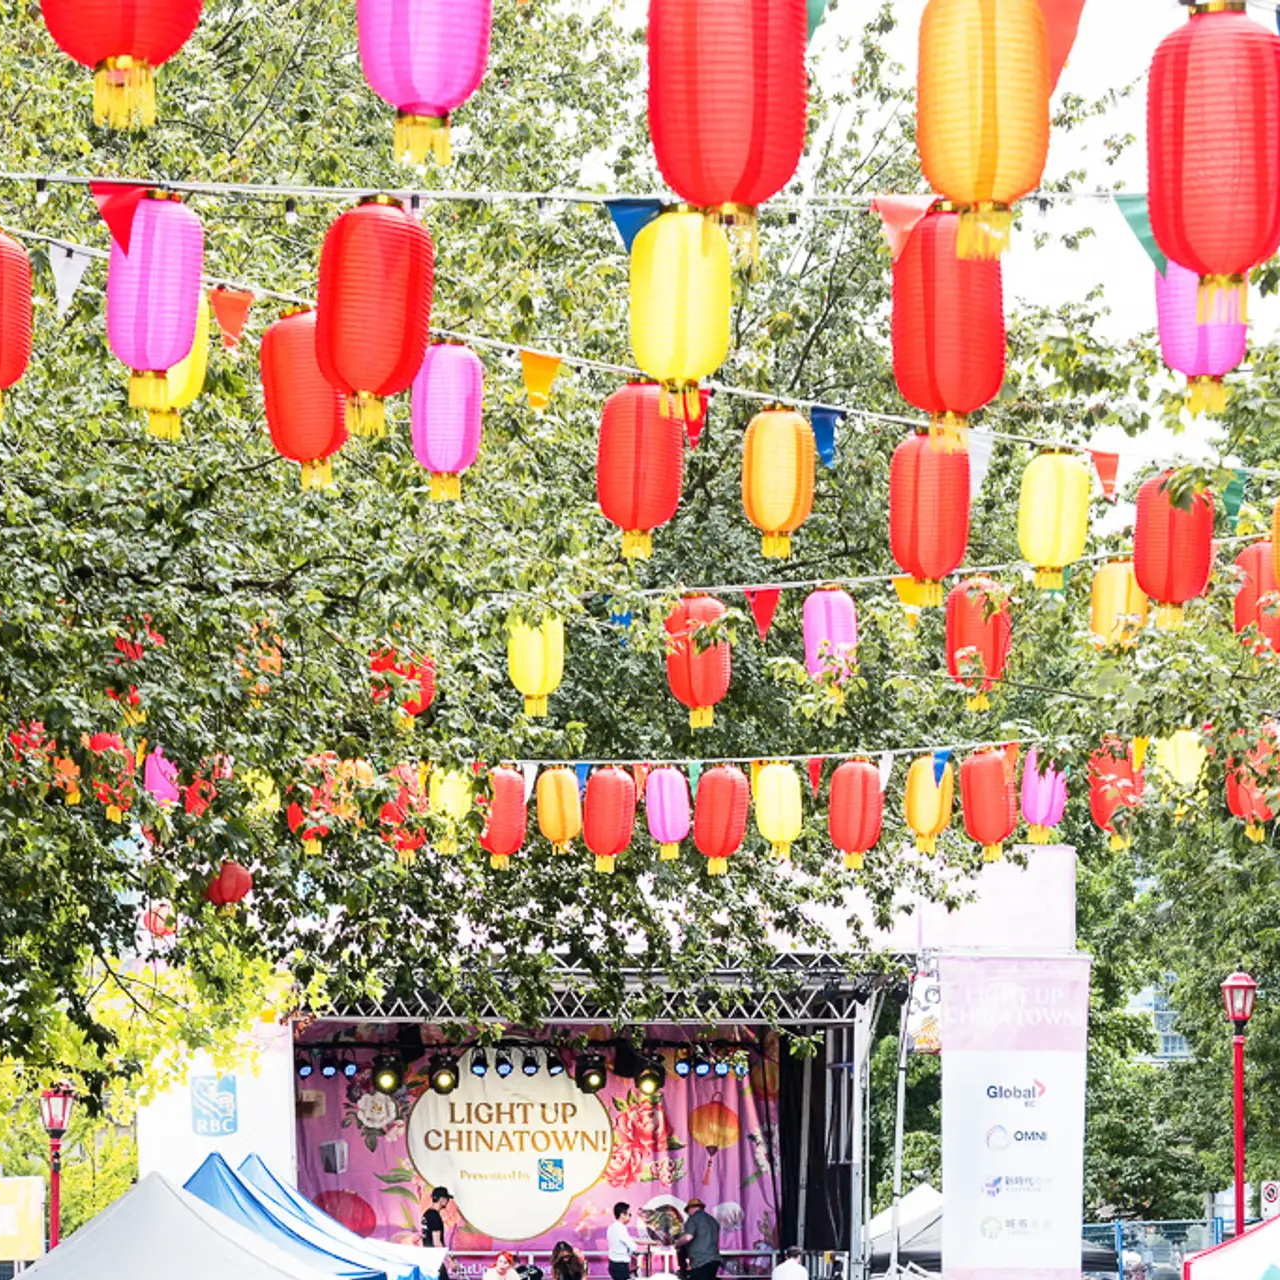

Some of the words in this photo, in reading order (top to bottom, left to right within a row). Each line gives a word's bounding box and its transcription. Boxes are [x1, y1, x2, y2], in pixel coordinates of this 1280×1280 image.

[986, 1085, 1036, 1099] Global
[449, 1102, 534, 1124] LIGHT
[540, 1102, 578, 1124] UP
[196, 1119, 235, 1132] RBC
[423, 1129, 608, 1152] CHINATOWN!
[1013, 1131, 1048, 1141] OMNI
[459, 1170, 516, 1181] Presented
[518, 1170, 531, 1182] by
[540, 1181, 563, 1190] RBC
